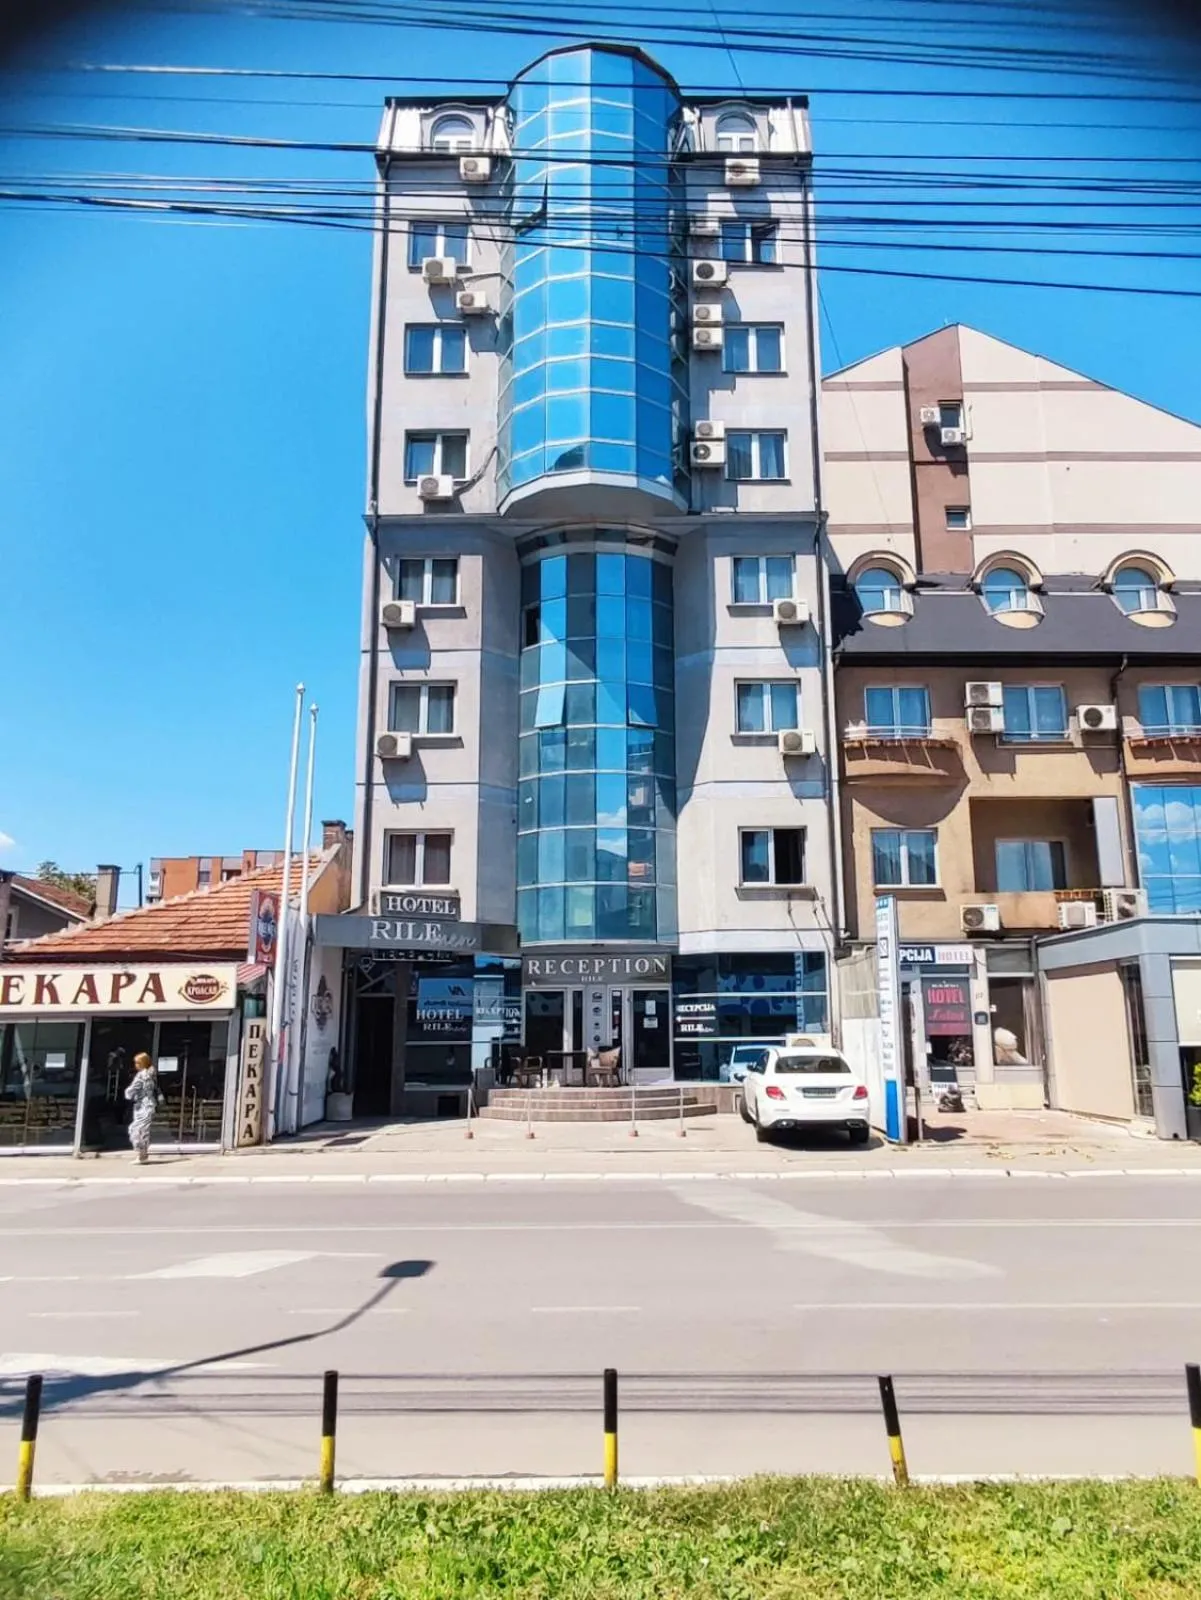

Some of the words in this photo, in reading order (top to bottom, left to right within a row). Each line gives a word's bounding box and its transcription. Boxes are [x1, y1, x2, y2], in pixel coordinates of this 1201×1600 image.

[386, 895, 457, 915] HOTEL
[369, 919, 442, 941] RILE
[899, 948, 933, 962] PCIJA
[938, 951, 971, 961] HOTEL
[528, 958, 667, 975] RECEPTION
[0, 971, 168, 1006] ЕКАРА
[927, 988, 966, 1004] HOTEL
[416, 1008, 464, 1021] HOTEL
[242, 1024, 261, 1138] ПЕКАРА
